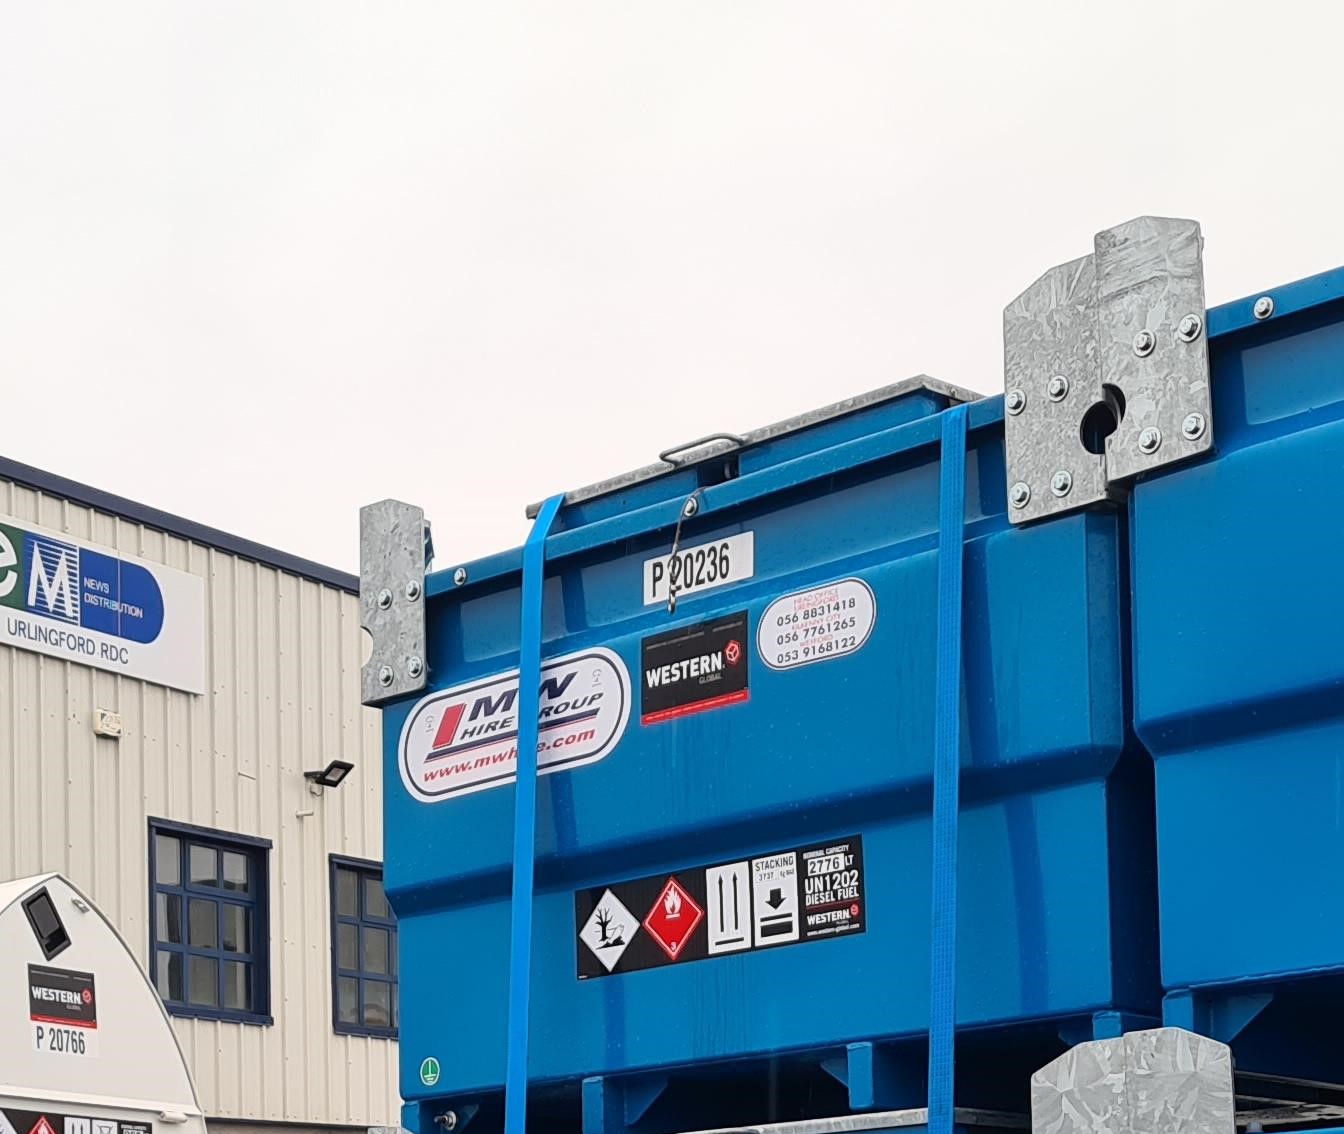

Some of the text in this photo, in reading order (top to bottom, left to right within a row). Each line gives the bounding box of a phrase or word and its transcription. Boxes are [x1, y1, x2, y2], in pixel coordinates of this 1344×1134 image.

[652, 542, 730, 598] P 20236
[84, 577, 109, 594] NEWS
[84, 592, 143, 619] DISTRIBUTION
[776, 598, 855, 627] 056 8831418
[7, 616, 129, 665] URLINGFORD RDC
[776, 617, 855, 645] 056 7761265
[776, 636, 855, 664] 053 9168122
[646, 651, 722, 688] WESTERN
[460, 715, 515, 740] HIRE
[538, 692, 605, 720] ROUP
[755, 856, 794, 872] STACKING
[809, 855, 854, 874] 2776 LT
[805, 870, 859, 894] UN1202
[806, 887, 859, 906] DIESEL FUEL
[807, 908, 850, 926] WESTERN
[31, 986, 81, 1005] WESTERN
[36, 1026, 85, 1054] P 20766
